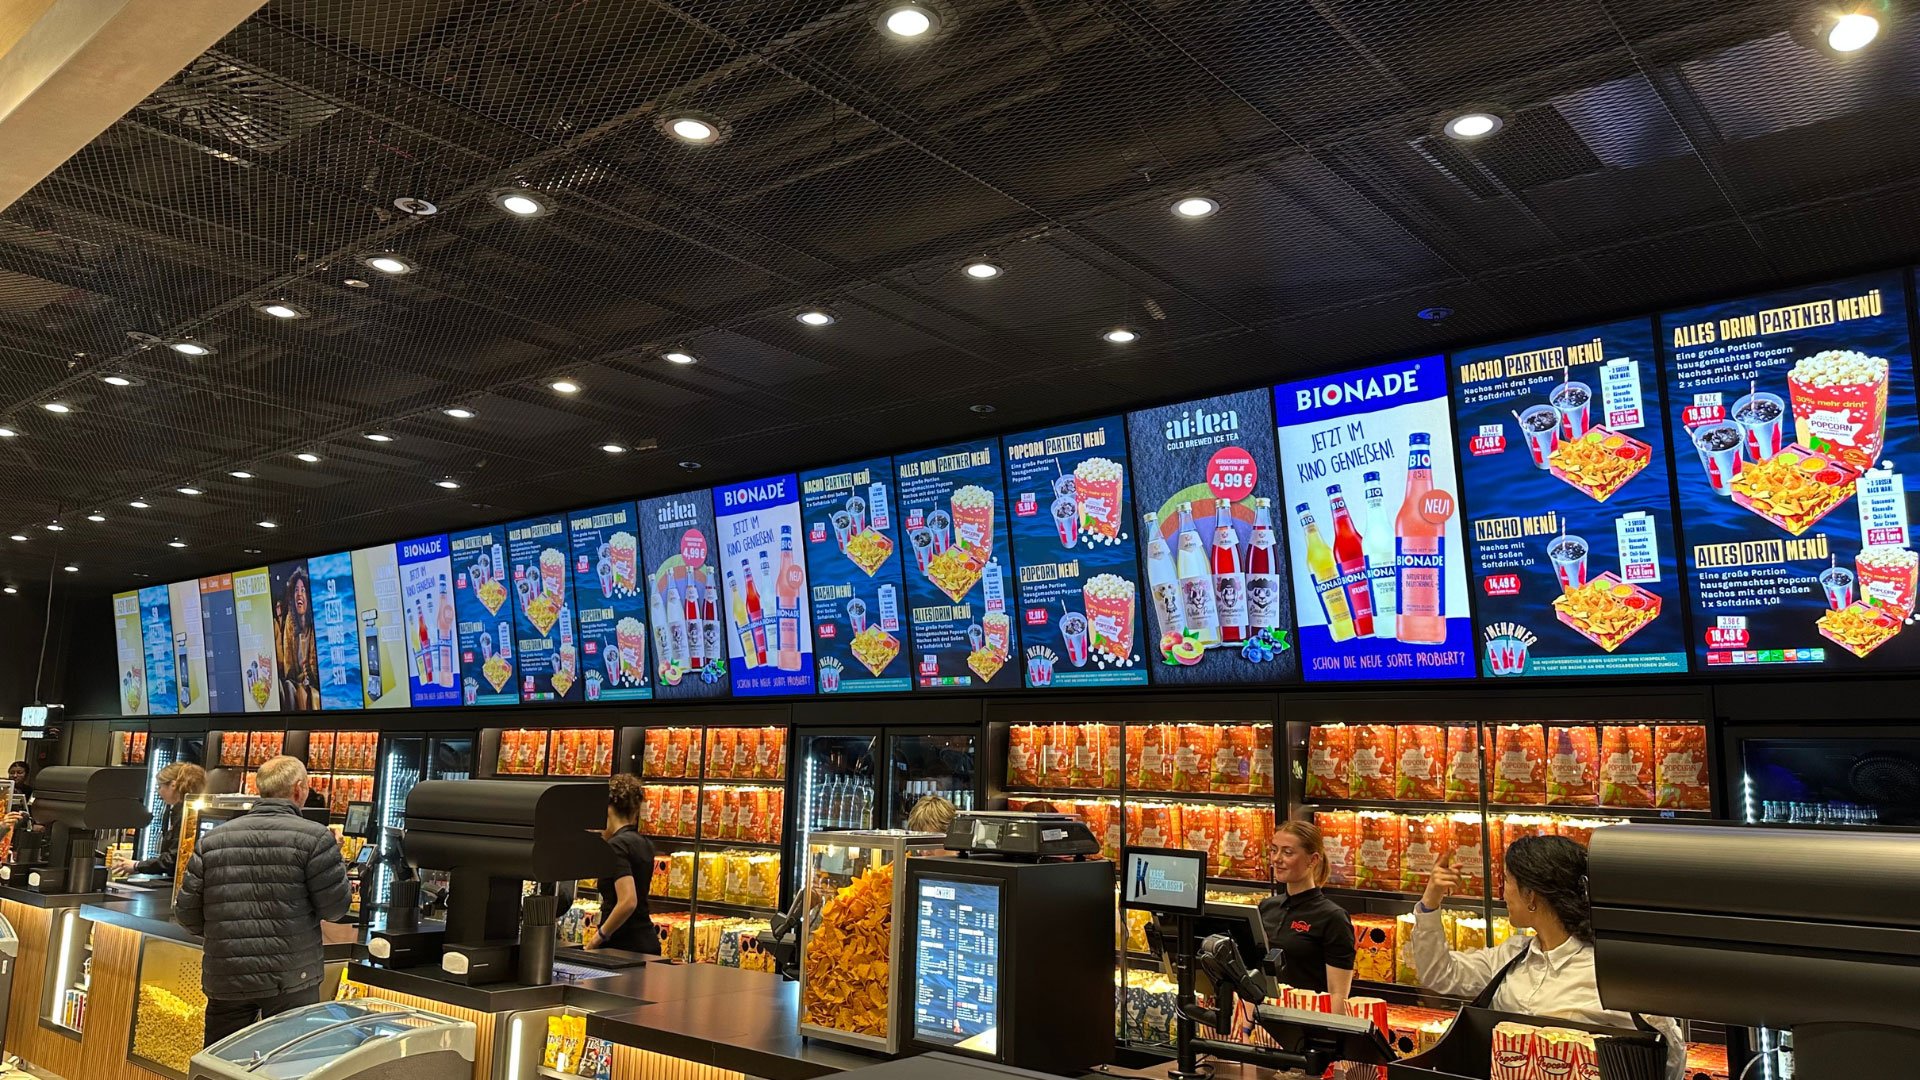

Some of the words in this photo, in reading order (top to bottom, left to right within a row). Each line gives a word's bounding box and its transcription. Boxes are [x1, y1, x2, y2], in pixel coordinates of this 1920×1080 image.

[1674, 322, 1714, 348] ALLES
[1720, 315, 1756, 341] DRIN
[1763, 303, 1831, 333] PARTNER
[1837, 289, 1881, 322] MENÜ
[1676, 351, 1695, 360] Eine
[1699, 348, 1725, 359] große
[1728, 341, 1762, 353] Portion
[1677, 353, 1750, 370] hausgemachtes
[1753, 346, 1793, 360] Popcorn
[1460, 359, 1502, 383] NACHO
[1507, 349, 1562, 375] PARTNER
[1568, 338, 1603, 366] MENÜ
[1678, 369, 1712, 379] Nachos
[1715, 365, 1731, 373] mit
[1734, 362, 1752, 371] drei
[1756, 357, 1785, 368] Soßen
[1464, 386, 1492, 395] Nachos
[1495, 382, 1508, 390] mit
[1511, 378, 1526, 388] drei
[1528, 375, 1553, 384] Soßen
[1695, 374, 1739, 386] Softdrink
[1296, 369, 1419, 411] BIONADE
[1478, 391, 1516, 402] Softdrink
[1811, 420, 1852, 432] POPCORN
[1009, 441, 1044, 460] POPCORN
[1046, 435, 1081, 454] PARTNER
[1083, 427, 1105, 449] MENÜ
[1167, 442, 1184, 450] COLD
[1186, 438, 1212, 448] BREWED
[1214, 436, 1224, 444] ICE
[1226, 433, 1239, 442] TEA
[1312, 426, 1341, 454] JETZT
[1347, 420, 1365, 442] IM
[900, 463, 918, 478] ALLES
[920, 460, 937, 475] DRIN
[939, 454, 969, 472] PARTNER
[971, 447, 990, 467] MENÜ
[1409, 454, 1431, 467] BIO
[1297, 459, 1326, 484] KINO
[804, 479, 824, 494] NACHO
[826, 473, 852, 490] PARTNER
[853, 468, 870, 486] MENÜ
[1211, 473, 1242, 490] 4,99
[1244, 473, 1253, 487] €
[724, 482, 785, 506] BIONADE
[1366, 489, 1382, 498] BIO
[1330, 500, 1344, 510] BIO
[1424, 498, 1449, 516] NEU!
[733, 518, 748, 536] JETZT
[751, 515, 759, 529] IM
[1476, 518, 1519, 540] NACHO
[1523, 511, 1557, 536] MENÜ
[404, 540, 441, 558] BIONADE
[1480, 543, 1508, 551] Nachos
[1698, 545, 1738, 567] ALLES
[1743, 543, 1780, 563] DRIN
[1786, 534, 1828, 561] MENÜ
[1397, 555, 1443, 566] BIONADE
[1482, 560, 1518, 568] Softdrink
[1021, 565, 1056, 581] POPCORN
[1058, 559, 1079, 578] MENÜ
[1722, 569, 1748, 580] große
[1751, 567, 1786, 576] Portion
[327, 579, 336, 598] SO
[814, 587, 834, 600] NACHO
[835, 582, 851, 598] MENÜ
[1510, 577, 1516, 588] €
[1700, 578, 1775, 589] hausgemachtes
[1778, 576, 1817, 586] Popcorn
[1701, 590, 1735, 598] Nachos
[1758, 587, 1776, 595] drei
[1779, 585, 1810, 594] Soßen
[1716, 597, 1761, 607] Softdrink
[326, 603, 342, 622] EASY
[914, 608, 932, 622] ALLES
[934, 607, 951, 621] DRIN
[953, 602, 971, 620] MENÜ
[1486, 622, 1538, 646] MEHRWEG
[1737, 630, 1743, 641] €
[1313, 656, 1340, 670] SCHON
[1344, 655, 1357, 669] DIE
[1360, 654, 1382, 669] NEUE
[1387, 654, 1413, 668] SORTE
[1417, 651, 1465, 666] PROBIERT?
[333, 667, 346, 685] SEIN
[1608, 764, 1637, 772] POPCORN
[1664, 764, 1698, 772] POPCORN
[1495, 1052, 1528, 1063] Popcorn
[1537, 1056, 1571, 1070] Popcorn
